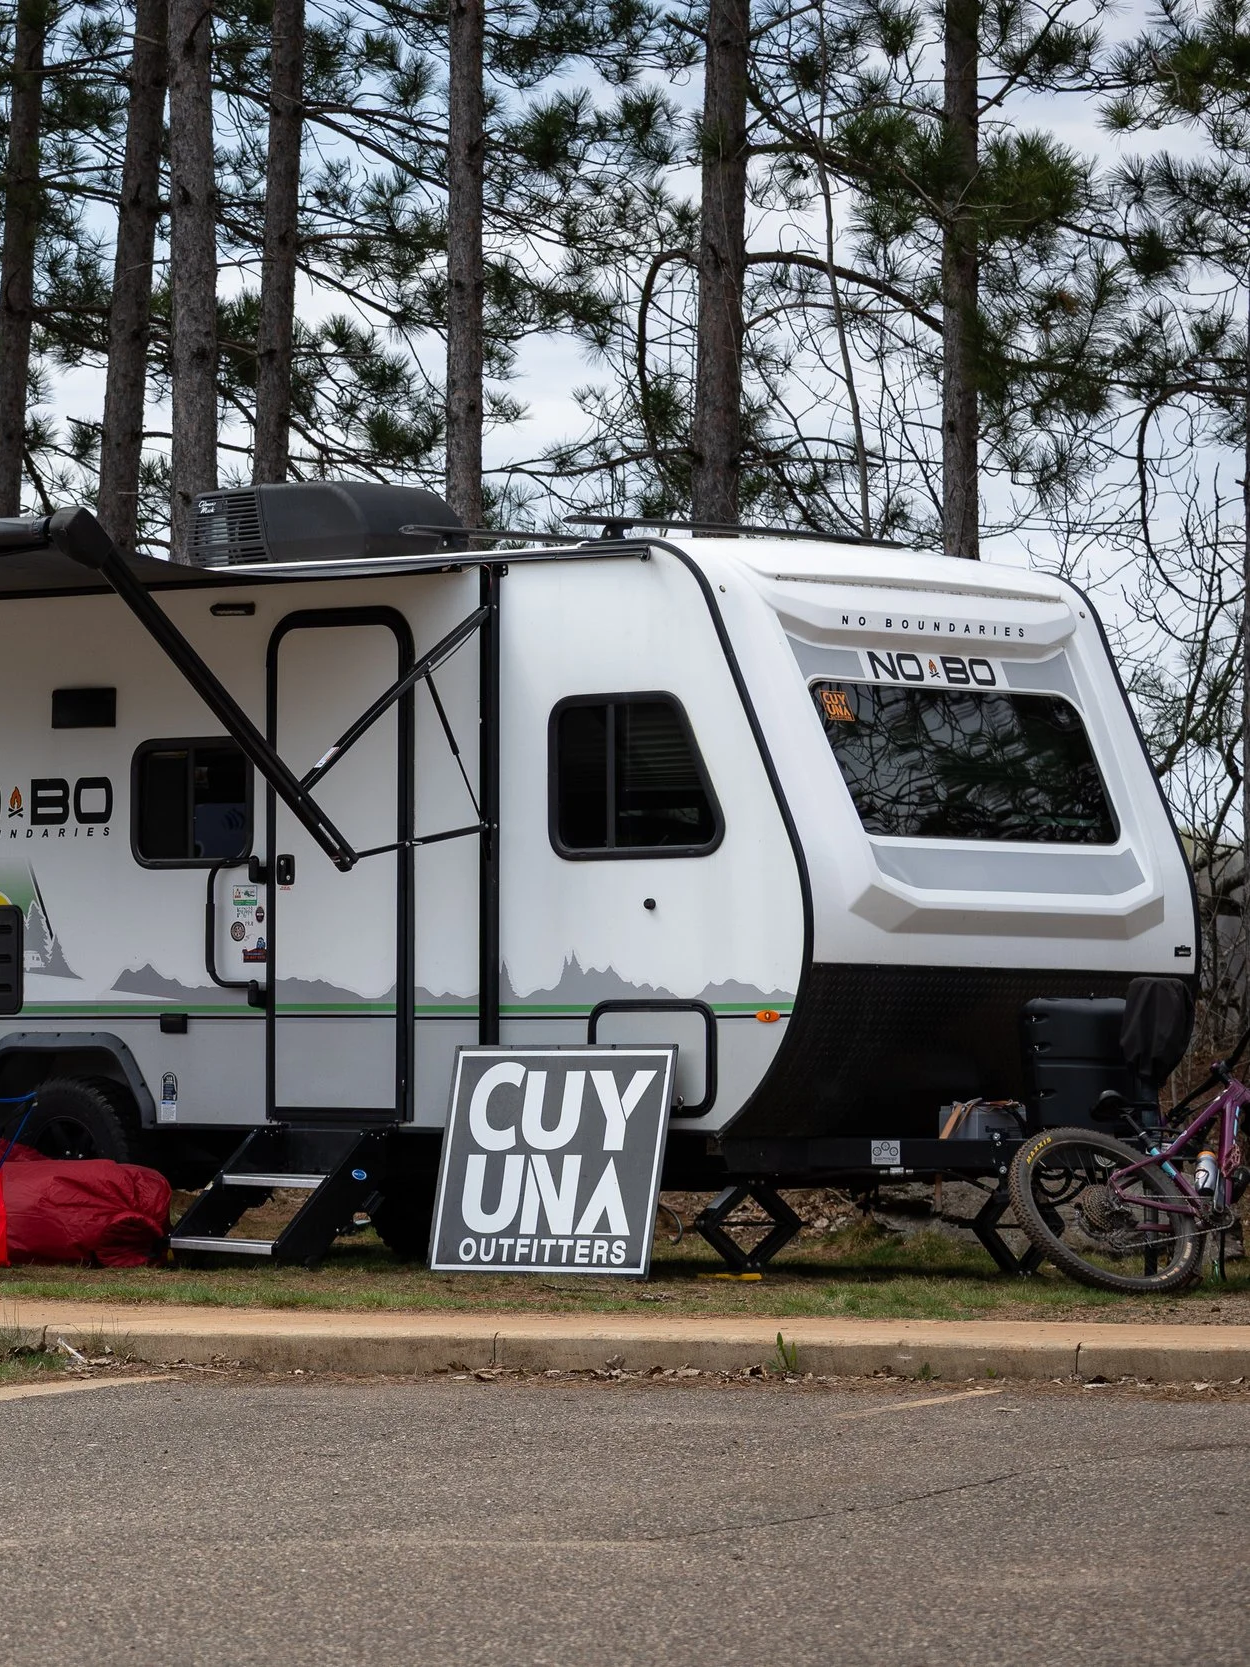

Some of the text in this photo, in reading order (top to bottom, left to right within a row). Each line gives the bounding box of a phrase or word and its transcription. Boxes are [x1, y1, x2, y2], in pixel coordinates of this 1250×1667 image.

[841, 615, 1025, 638] NO BOUNDARIES
[822, 692, 846, 706] CUY
[826, 703, 852, 716] UNA
[469, 1061, 658, 1151] CUY
[1026, 1136, 1052, 1165] MAXXIS
[461, 1154, 631, 1236] UNA
[458, 1237, 627, 1265] OUTFITTERS
